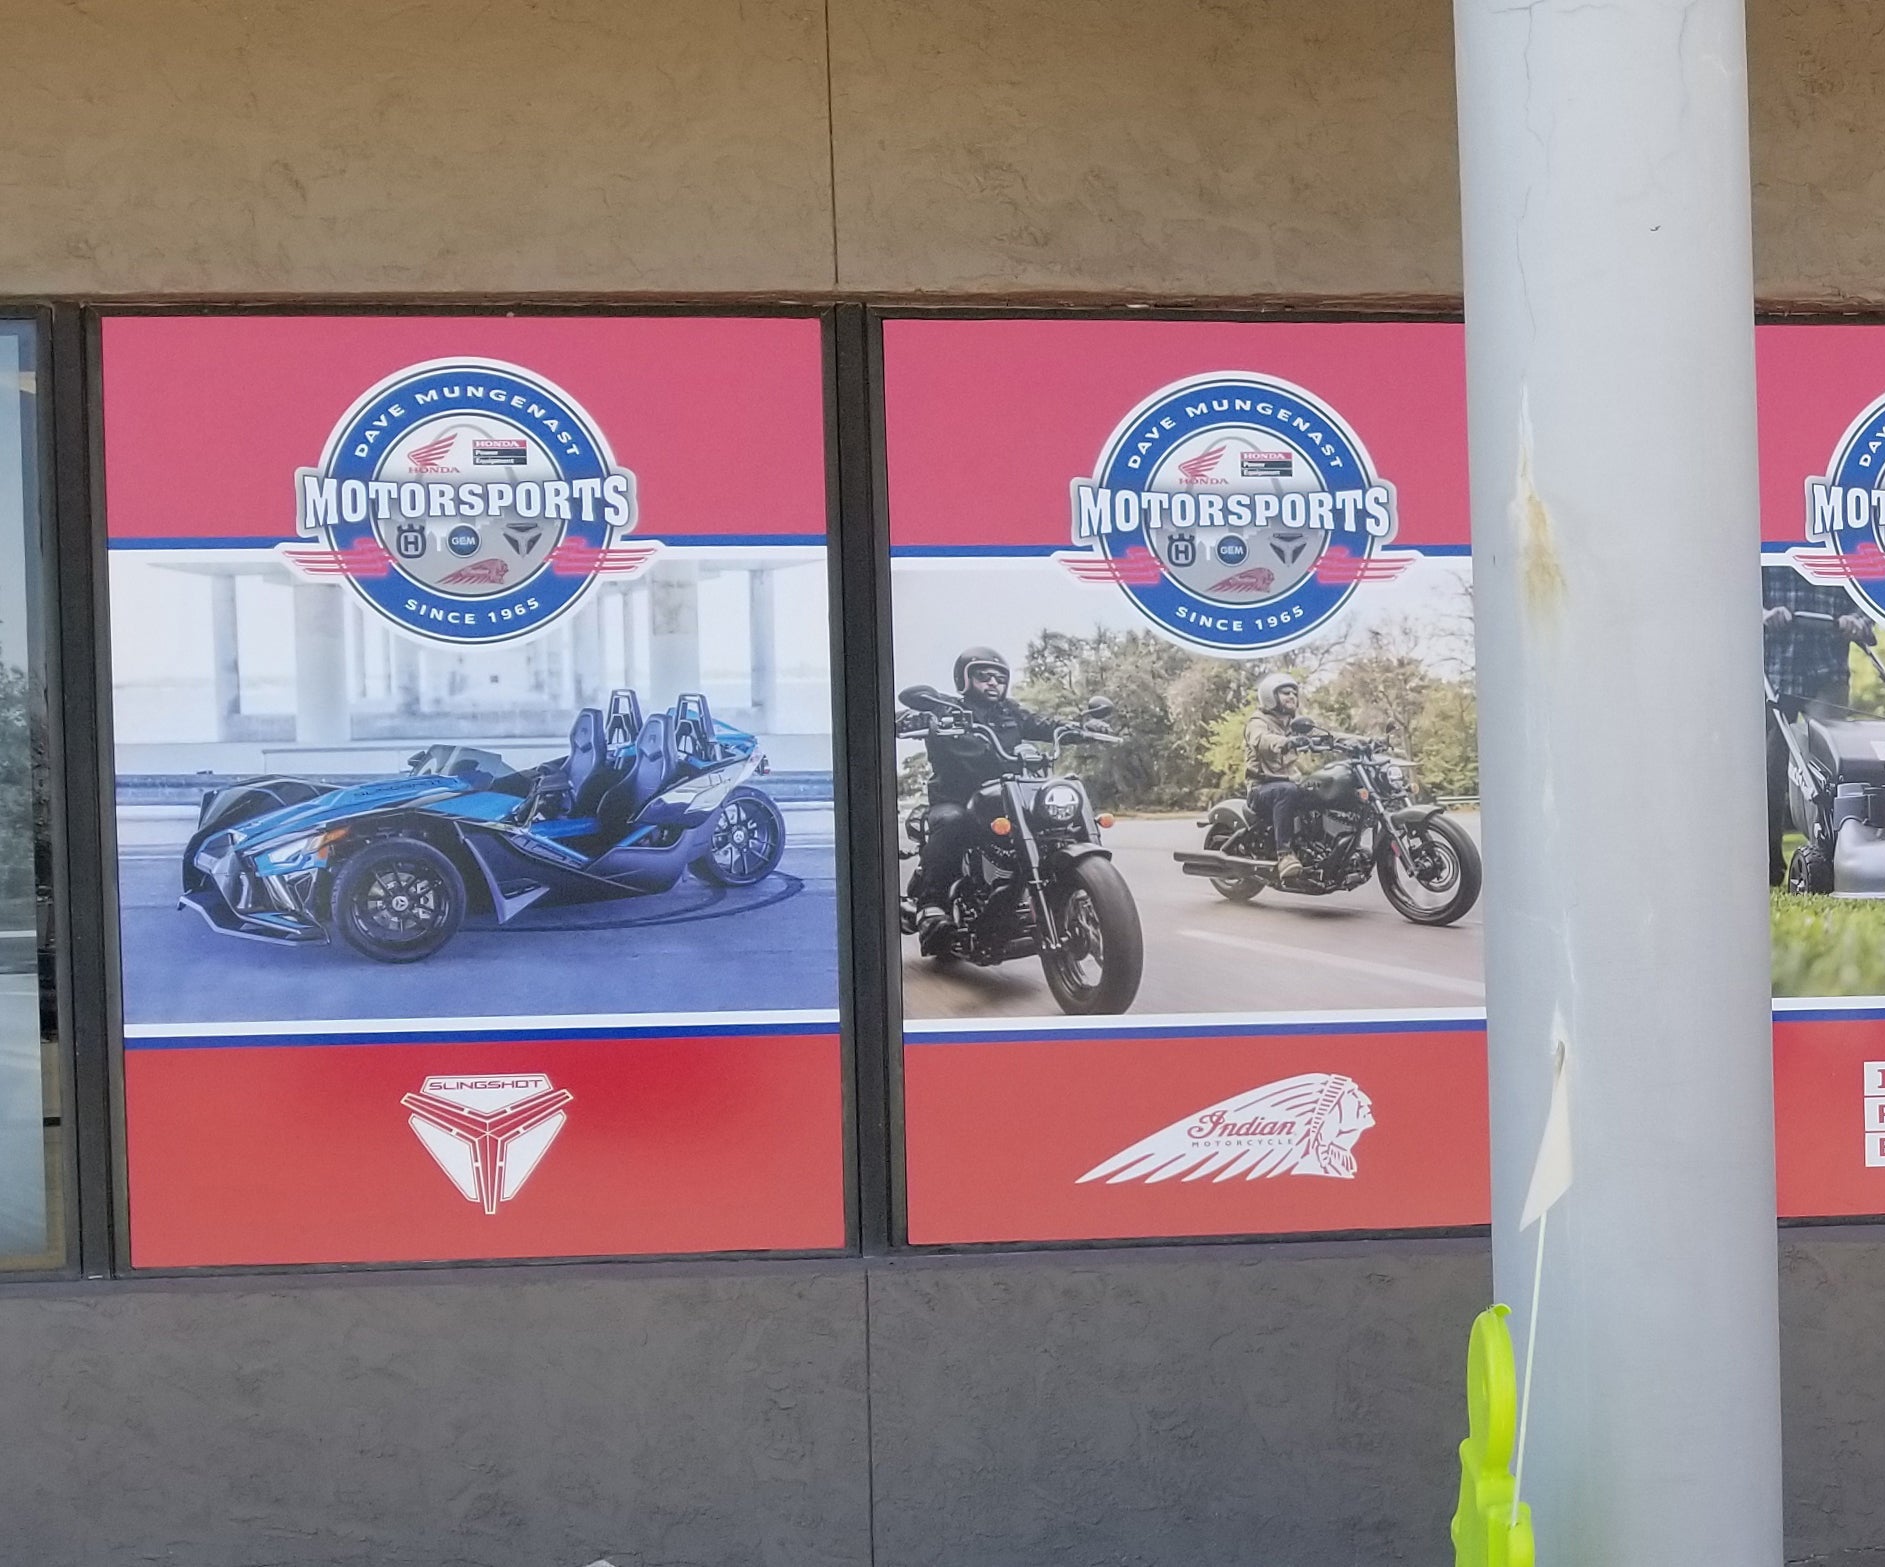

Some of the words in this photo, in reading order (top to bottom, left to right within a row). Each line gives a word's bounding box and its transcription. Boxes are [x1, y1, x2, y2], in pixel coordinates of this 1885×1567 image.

[355, 404, 405, 458] DAVE
[415, 386, 580, 457] MUNGENAST
[1128, 416, 1176, 469] DAVE
[1185, 399, 1343, 469] MUNGENAST
[408, 466, 460, 474] HONDA
[303, 475, 629, 529] MOTORSPORTS
[1079, 486, 1390, 538] MOTORSPORTS
[451, 537, 476, 545] GEM
[1220, 546, 1244, 555] GEM
[405, 599, 476, 624] SINCE
[488, 598, 539, 623] 1965
[1175, 606, 1243, 632] SINCE
[1255, 605, 1304, 630] 1965
[429, 1079, 543, 1091] SLINGSHOT
[1187, 1110, 1297, 1139] Indian
[1192, 1139, 1294, 1147] MOTORCYCLE
